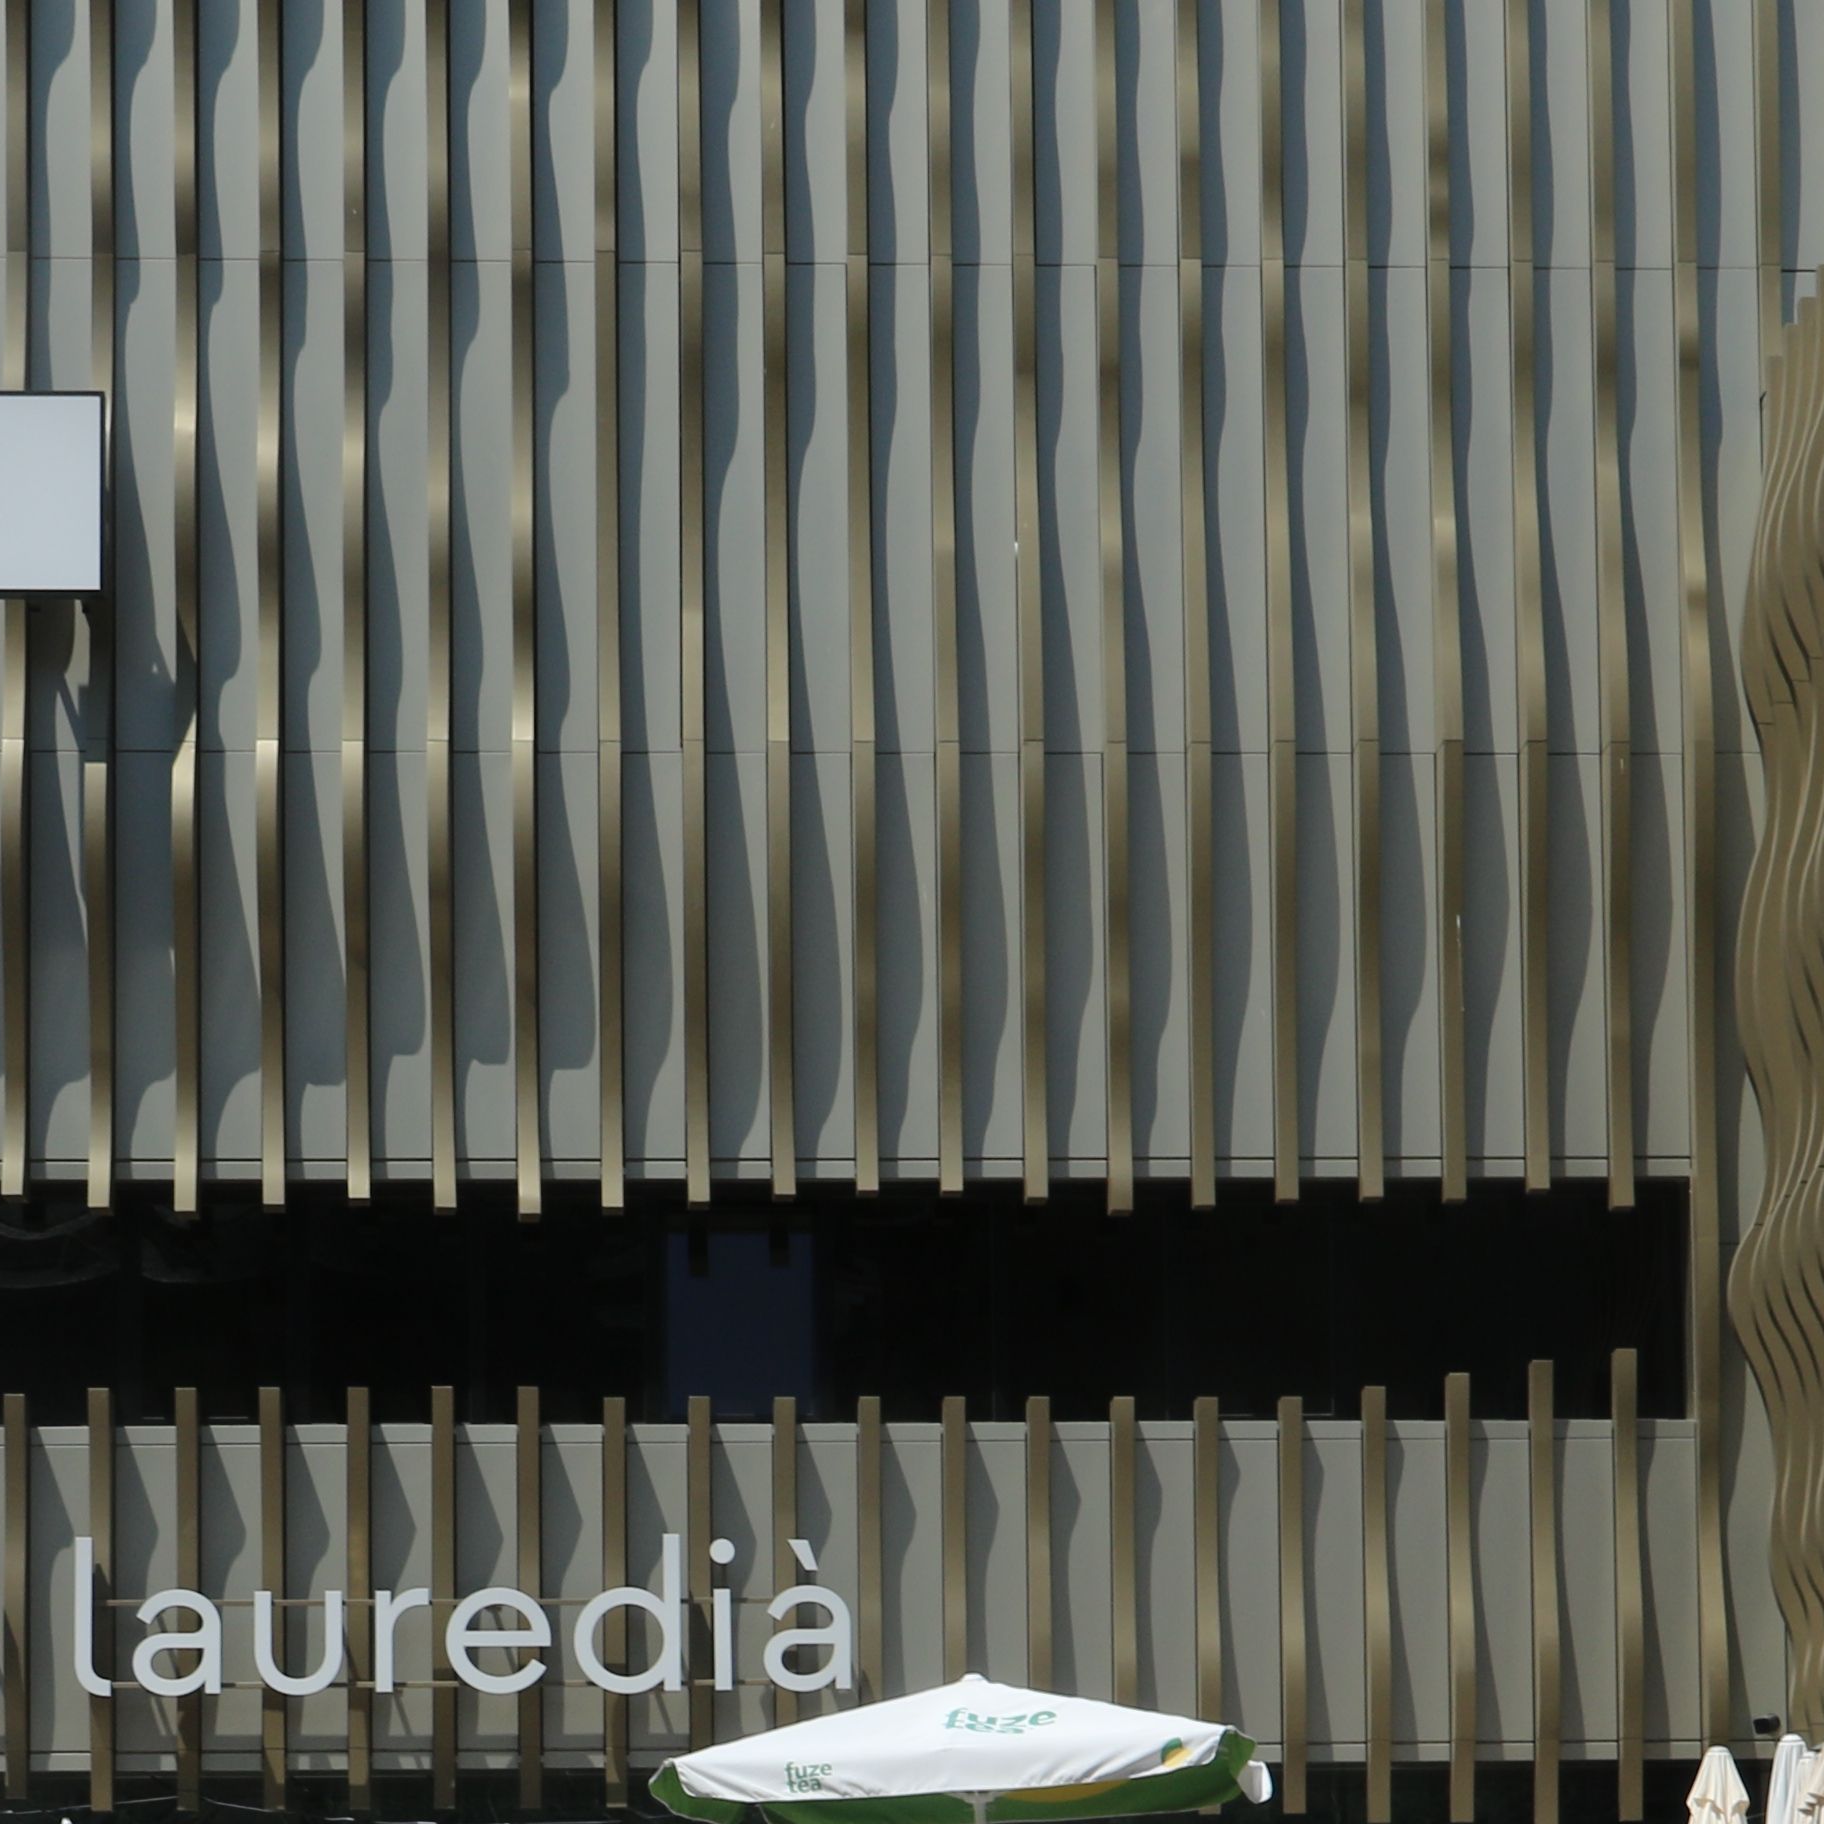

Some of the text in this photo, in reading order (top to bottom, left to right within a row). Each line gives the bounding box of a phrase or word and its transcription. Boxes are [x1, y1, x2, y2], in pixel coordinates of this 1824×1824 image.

[75, 1532, 852, 1697] lauredià
[784, 1760, 833, 1779] fuze
[785, 1777, 823, 1793] tea
